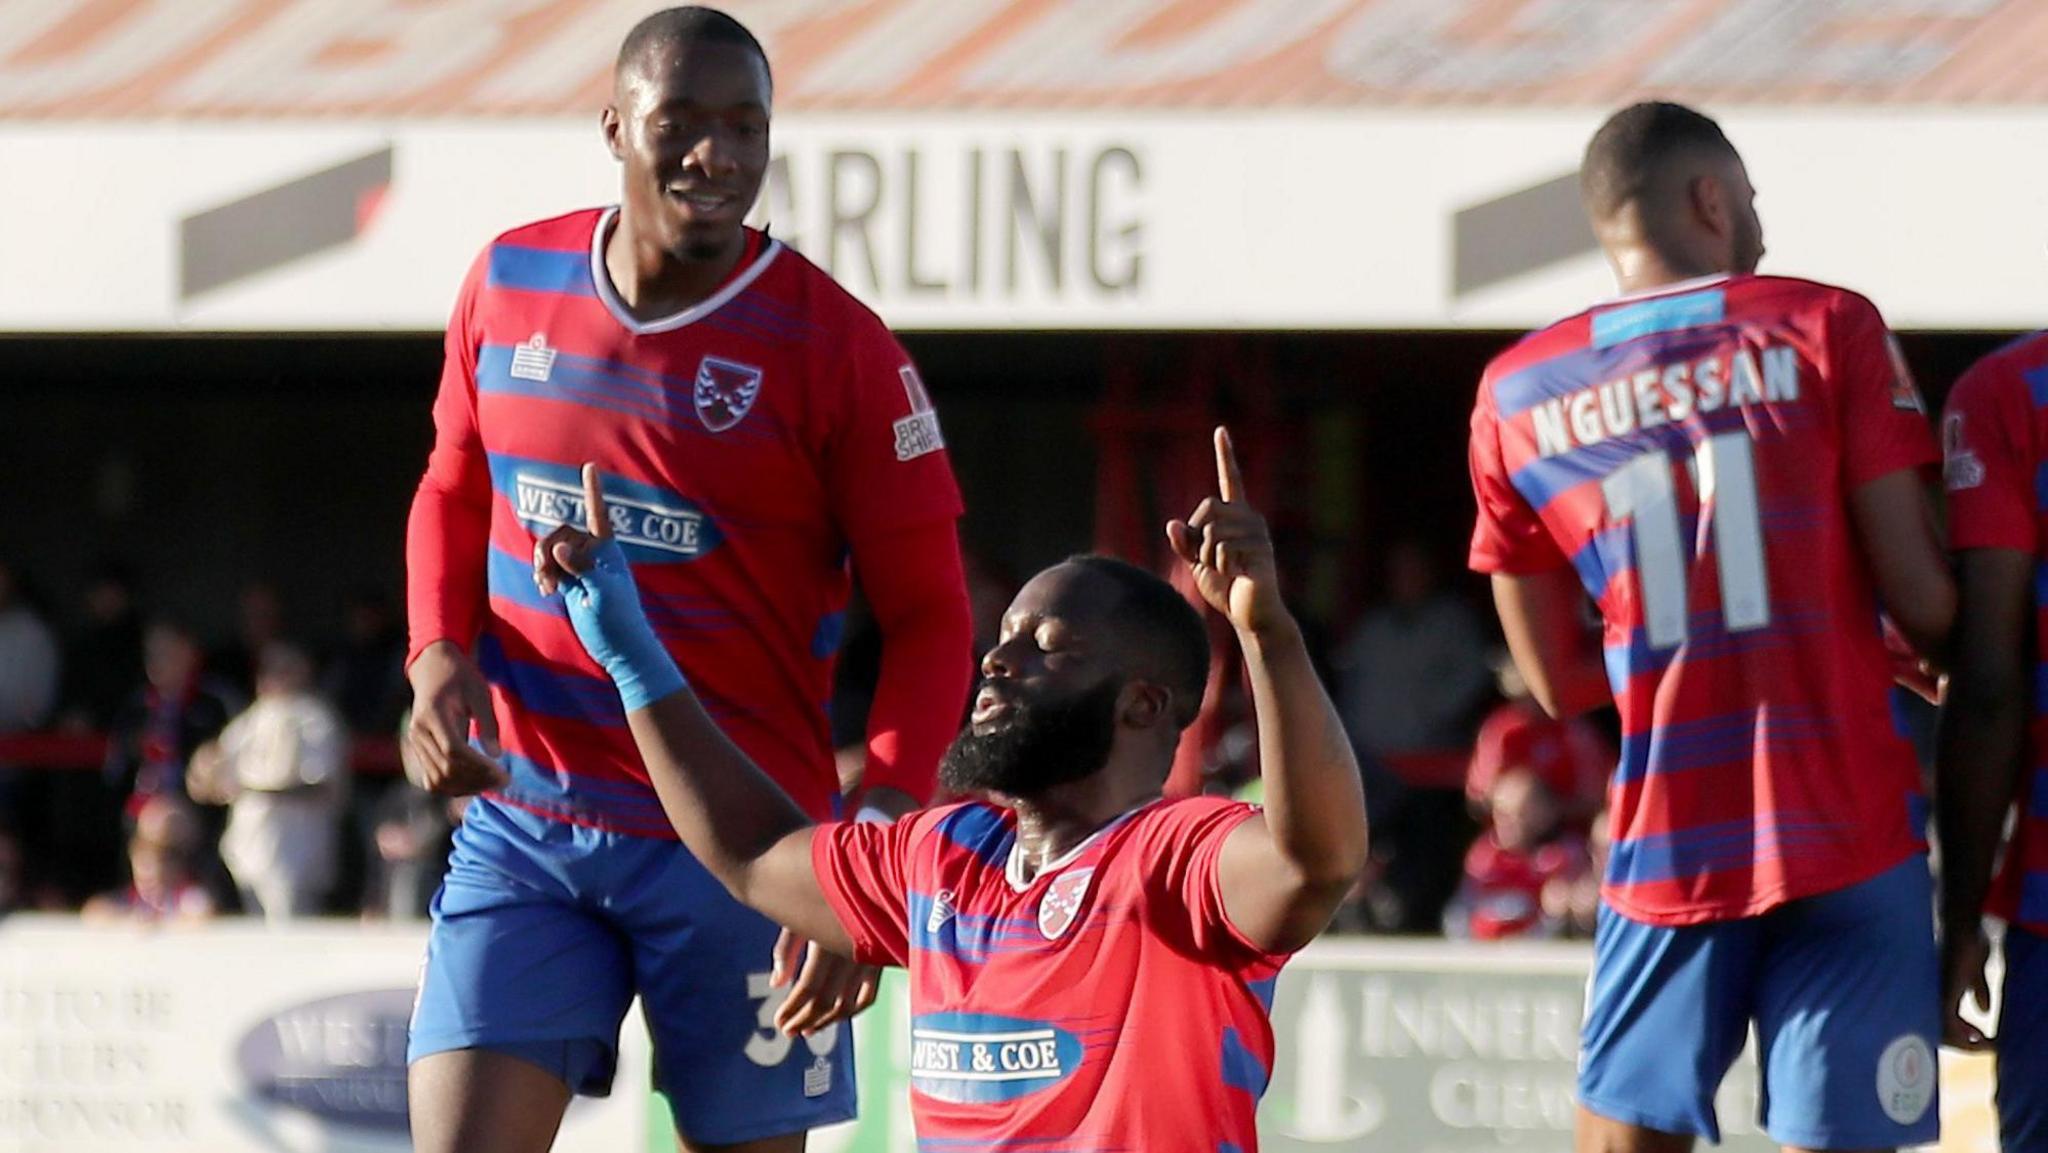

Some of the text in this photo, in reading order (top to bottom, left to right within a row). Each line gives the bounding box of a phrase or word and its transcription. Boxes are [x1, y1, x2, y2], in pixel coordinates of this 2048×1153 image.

[1530, 345, 1799, 458] N'GUESSAN
[516, 482, 700, 547] WEST & COE
[1602, 430, 1770, 651] 11
[972, 1042, 996, 1073] &
[1000, 1039, 1059, 1070] COE
